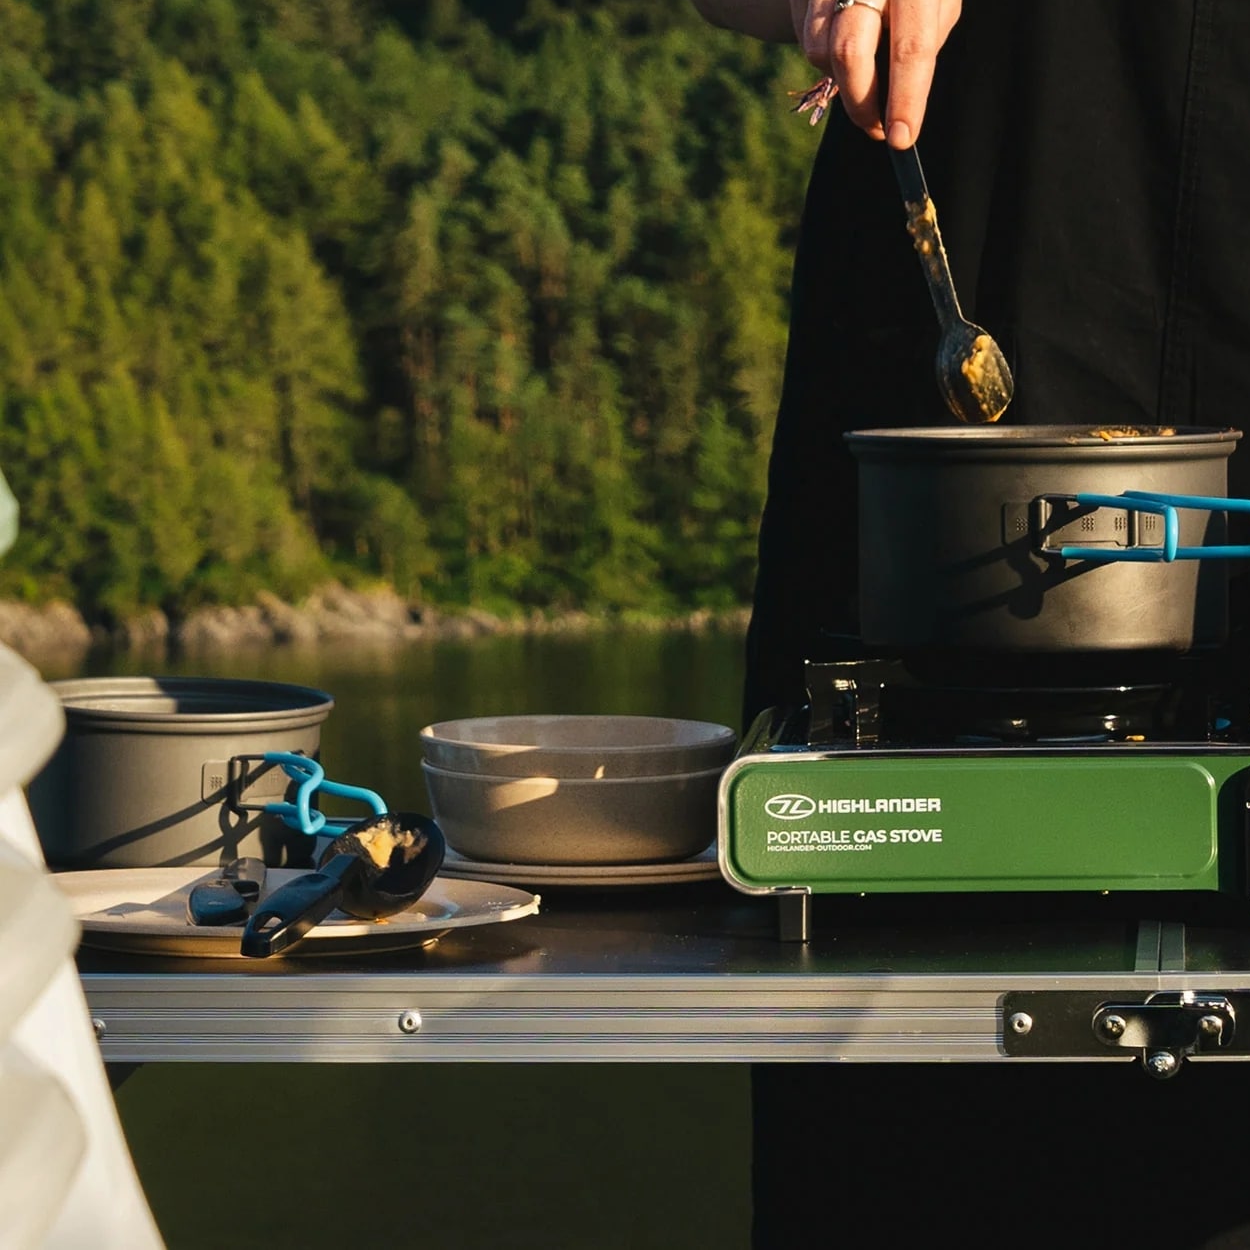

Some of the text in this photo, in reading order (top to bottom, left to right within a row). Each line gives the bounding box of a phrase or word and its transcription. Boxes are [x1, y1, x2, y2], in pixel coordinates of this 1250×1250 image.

[818, 798, 941, 814] HIGHLANDER
[767, 829, 943, 844] PORTABLE GAS STOVE
[767, 844, 872, 852] HIGHLANDER-OUTDOOR.COM
